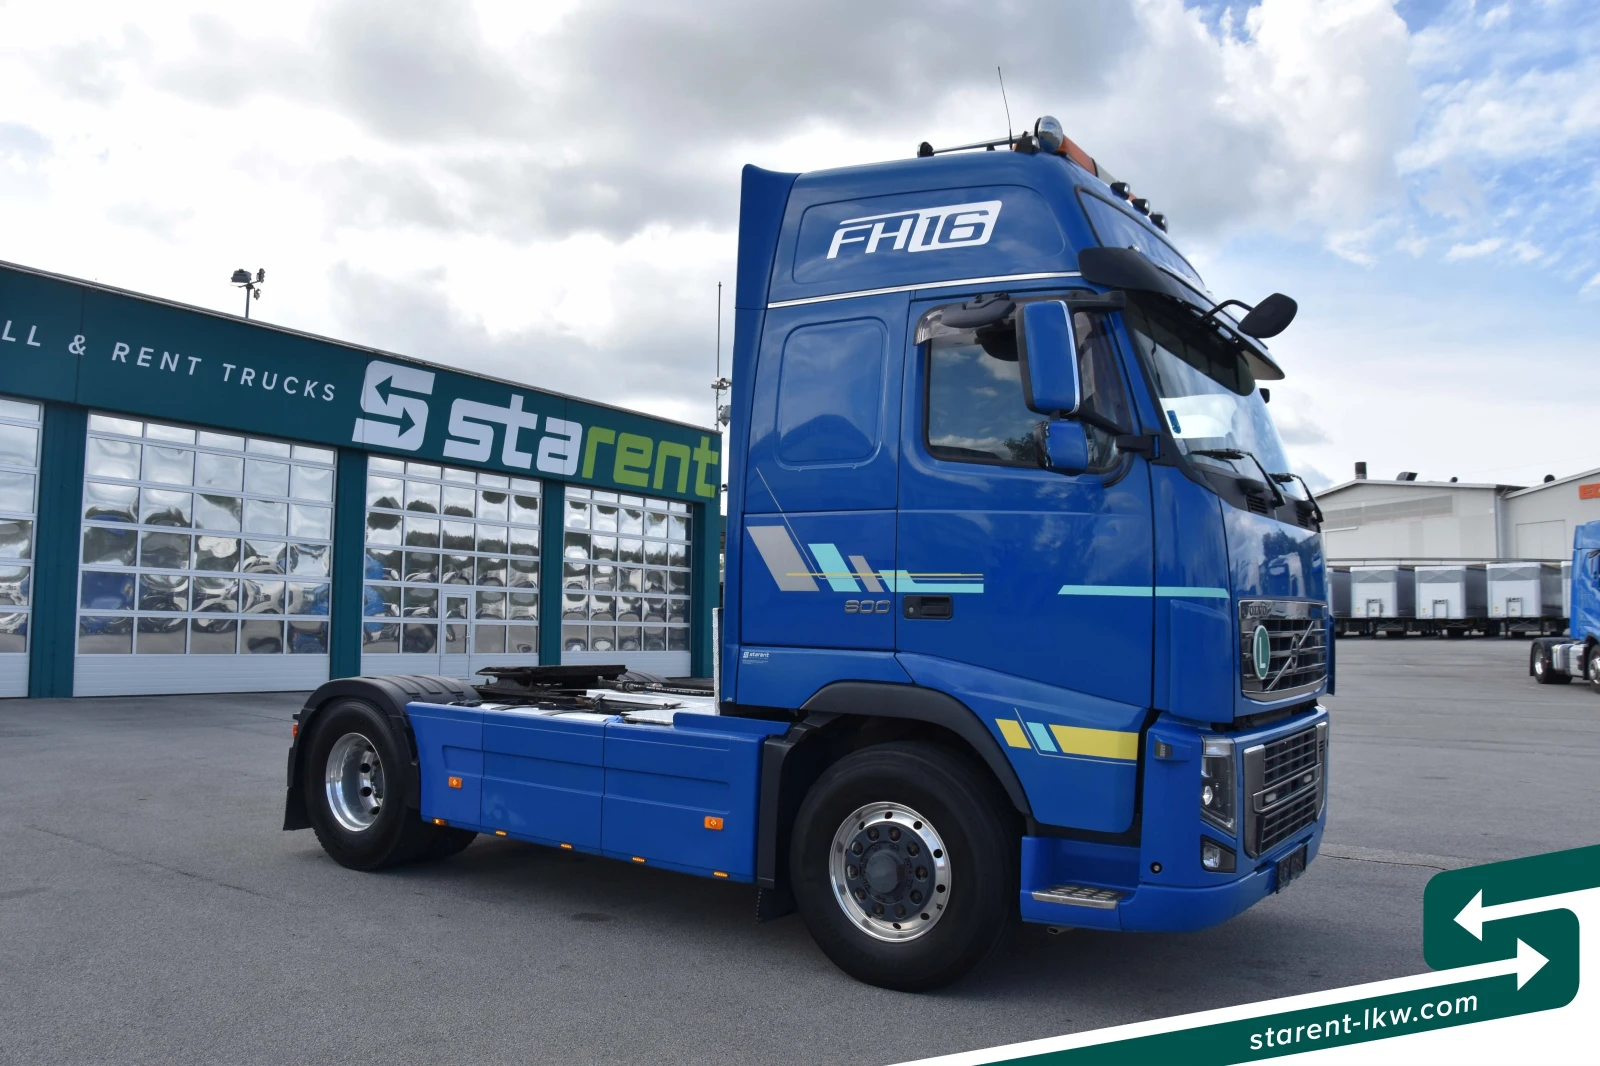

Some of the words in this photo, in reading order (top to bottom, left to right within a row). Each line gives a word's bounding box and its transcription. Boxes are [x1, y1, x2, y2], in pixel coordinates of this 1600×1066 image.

[826, 202, 1000, 259] FH16
[1, 320, 42, 347] LL
[67, 334, 87, 355] &
[111, 342, 202, 376] RENT
[222, 363, 336, 402] TRUCKS
[442, 393, 720, 499] starent
[1259, 637, 1266, 668] L
